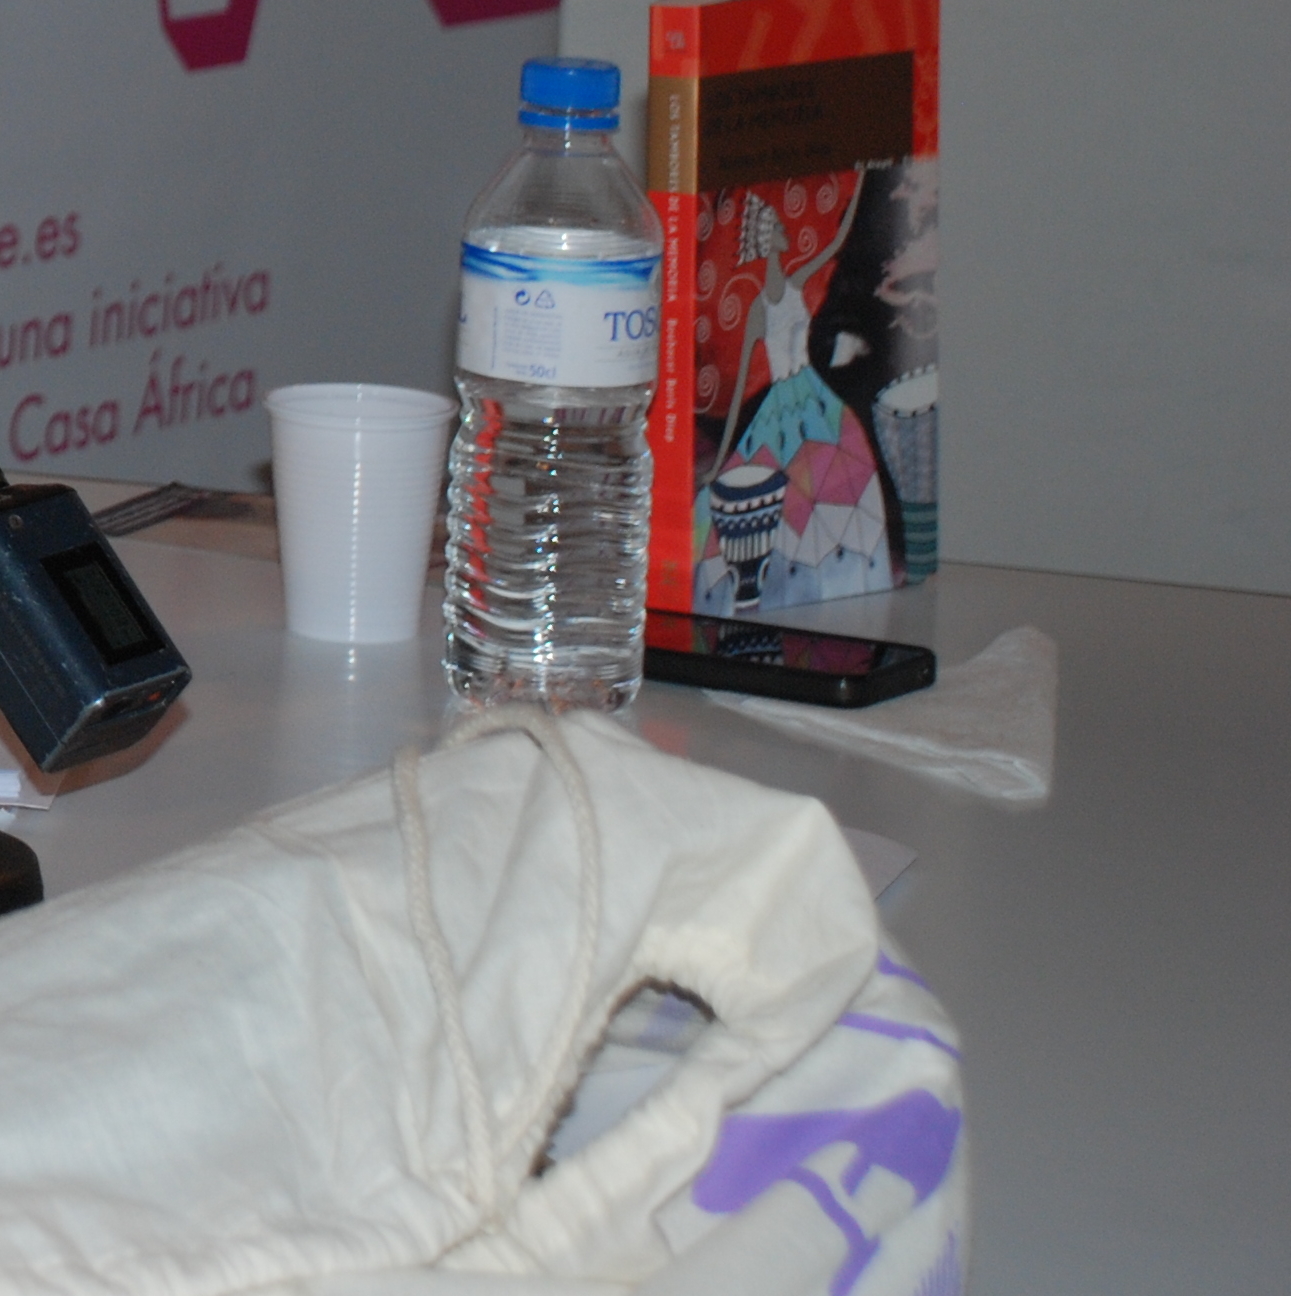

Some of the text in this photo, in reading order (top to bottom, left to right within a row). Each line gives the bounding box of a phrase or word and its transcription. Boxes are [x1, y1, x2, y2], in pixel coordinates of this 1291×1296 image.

[88, 260, 272, 349] iniciativa
[8, 349, 257, 463] Casa África
